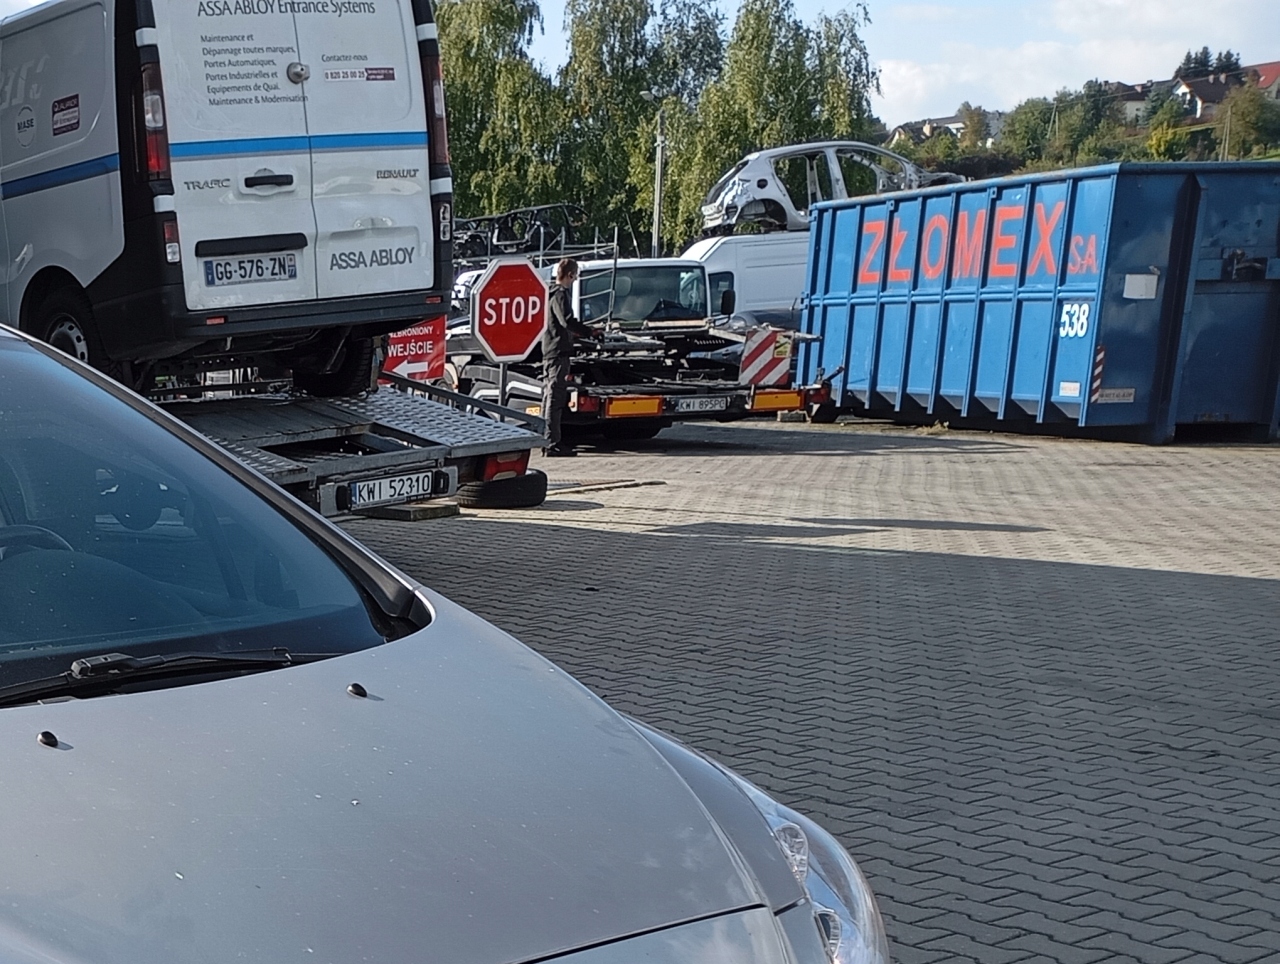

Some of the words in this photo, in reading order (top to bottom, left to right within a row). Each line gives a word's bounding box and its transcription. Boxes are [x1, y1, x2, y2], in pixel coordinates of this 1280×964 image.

[197, 0, 233, 17] ASSA
[234, 0, 275, 15] ABLOY
[278, 0, 330, 14] Entrance
[330, 0, 376, 18] Systems
[200, 34, 245, 43] Maintenance
[246, 34, 254, 42] et
[242, 46, 265, 54] toutes
[204, 60, 226, 69] Portes
[206, 73, 228, 82] Portes
[228, 71, 270, 80] Industrielles
[253, 83, 262, 91] de
[208, 97, 253, 106] Maintenance
[376, 168, 420, 180] RENAULT
[183, 178, 231, 190] TRAFIC
[858, 200, 1066, 284] ZŁOMEX
[329, 249, 367, 271] ASSA
[370, 246, 416, 268] ABLOY
[483, 296, 541, 326] STOP
[1059, 303, 1090, 338] 538
[387, 339, 434, 358] WEJŚCIE
[358, 481, 382, 503] KWI
[389, 474, 431, 498] 52310
